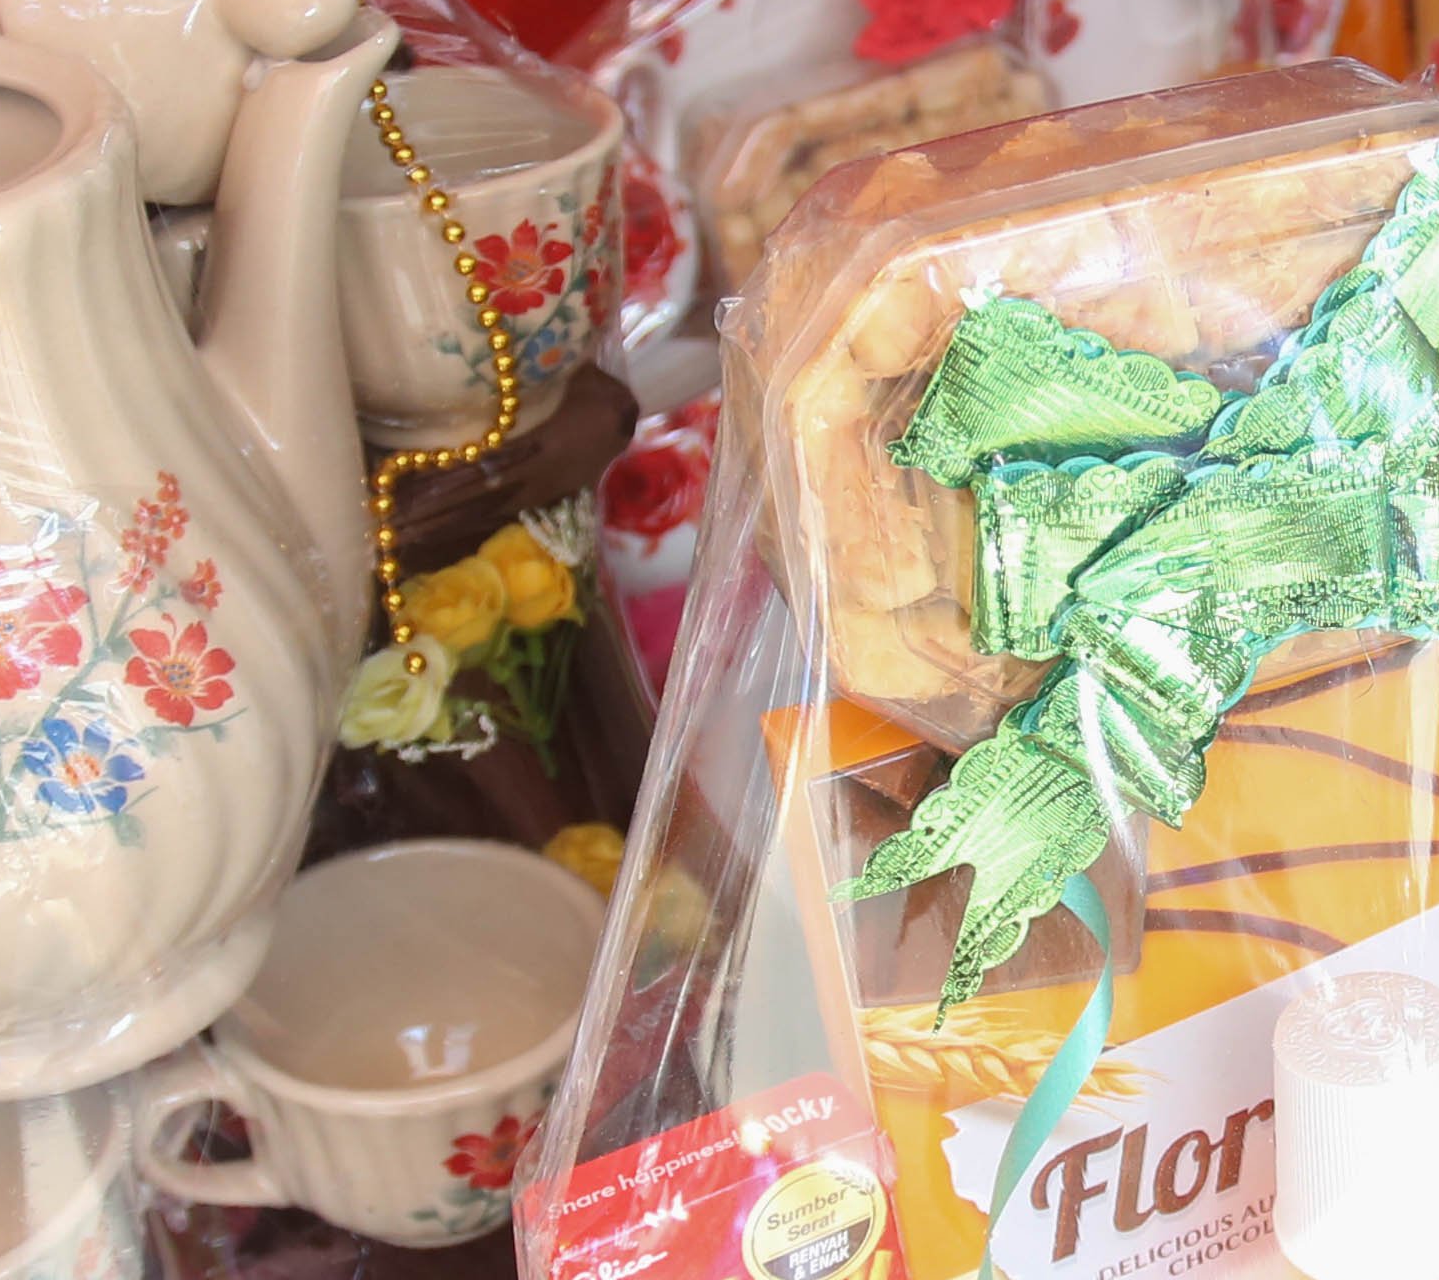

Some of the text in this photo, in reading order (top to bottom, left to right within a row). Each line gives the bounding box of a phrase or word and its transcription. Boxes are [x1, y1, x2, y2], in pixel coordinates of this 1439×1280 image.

[618, 1131, 741, 1191] happiness!
[766, 1185, 848, 1233] Sumber
[786, 1213, 837, 1243] Serat
[789, 1230, 850, 1270] RENYAH
[808, 1245, 850, 1276] ENAK
[1166, 1217, 1277, 1279] CHOCOL
